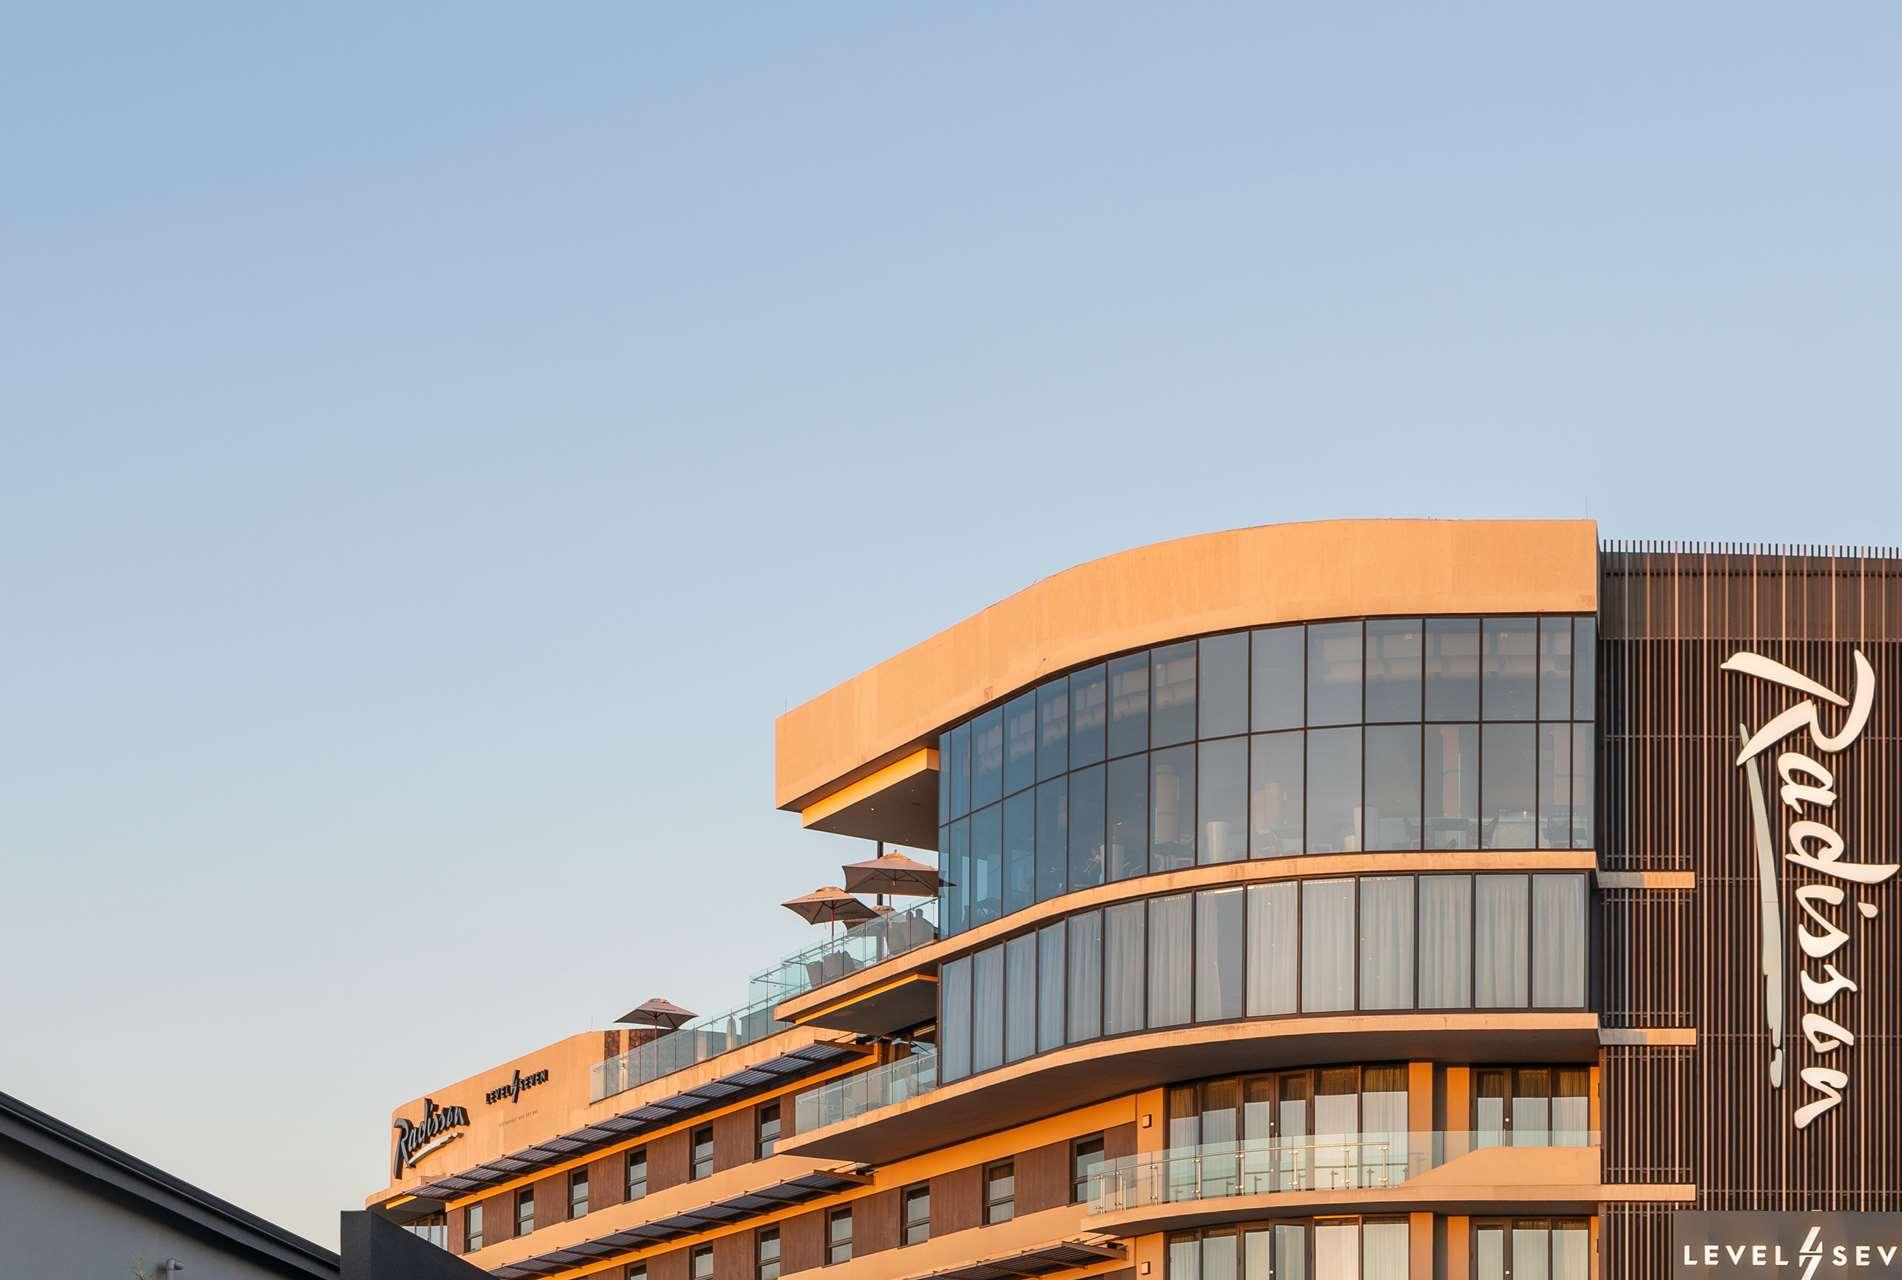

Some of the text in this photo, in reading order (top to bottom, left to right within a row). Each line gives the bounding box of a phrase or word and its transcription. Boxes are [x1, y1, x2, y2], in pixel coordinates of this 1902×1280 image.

[1719, 648, 1901, 1130] Radisson
[393, 1097, 471, 1180] Radisson
[1683, 1245, 1789, 1266] LEVEL
